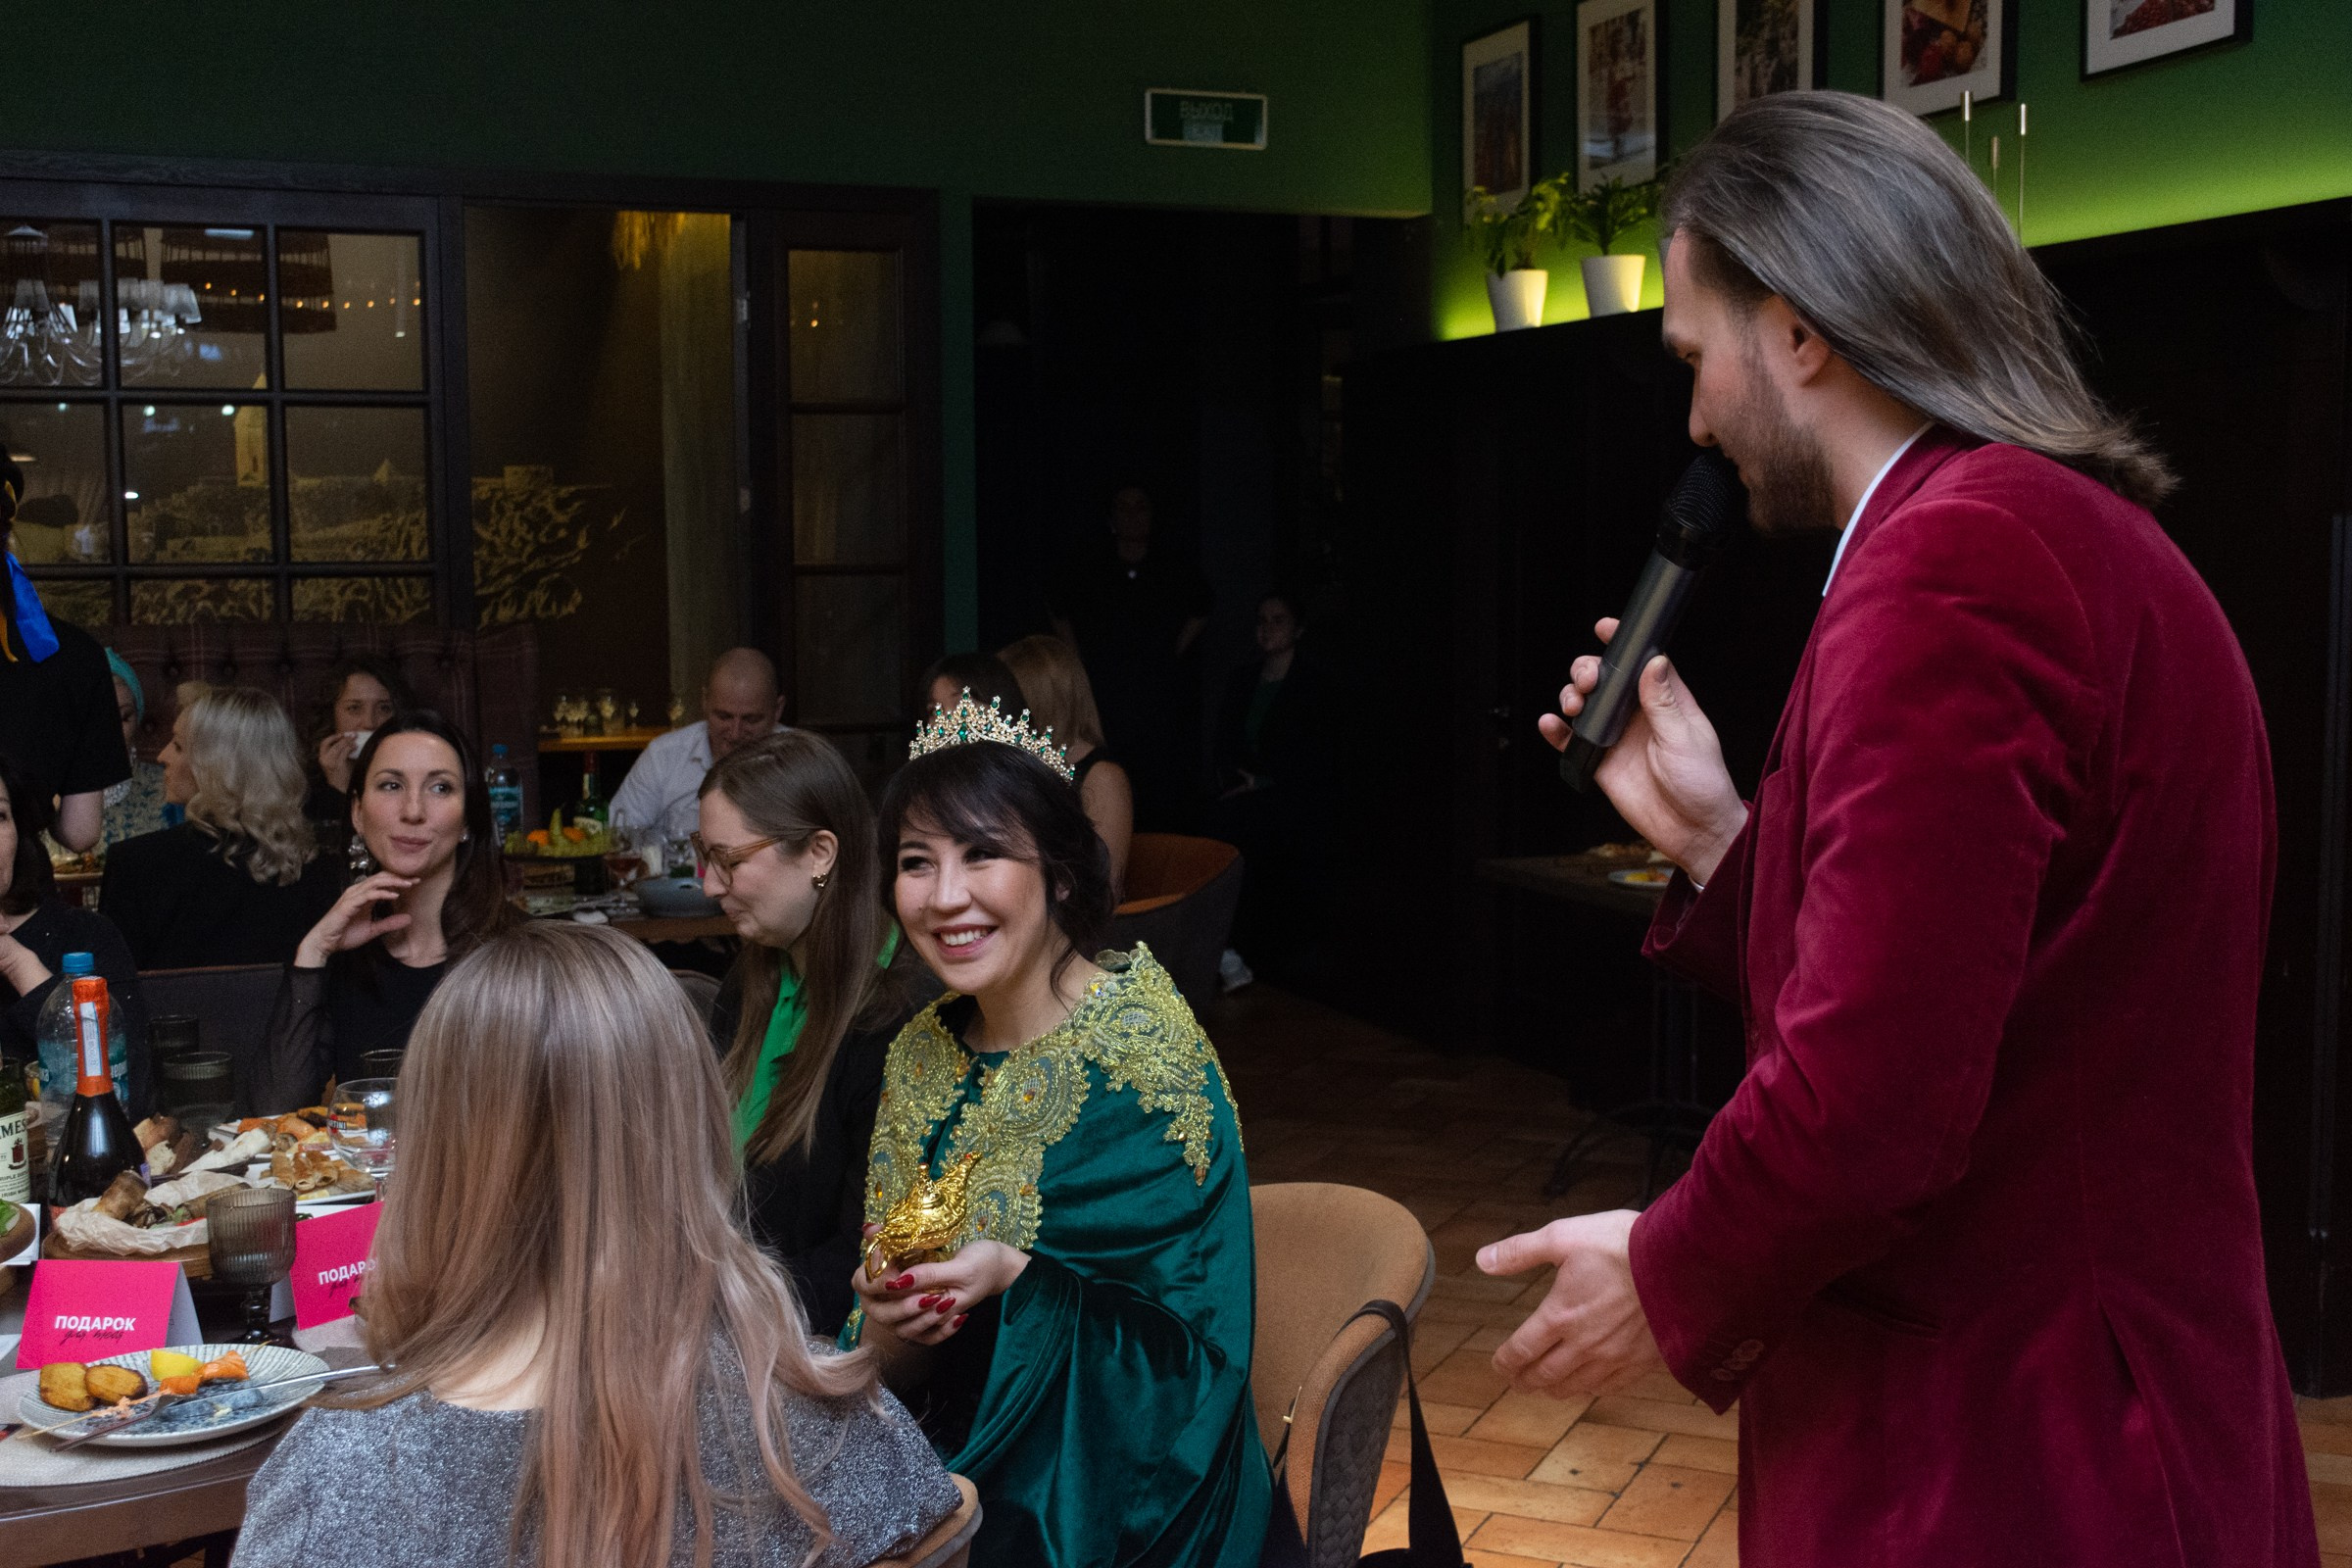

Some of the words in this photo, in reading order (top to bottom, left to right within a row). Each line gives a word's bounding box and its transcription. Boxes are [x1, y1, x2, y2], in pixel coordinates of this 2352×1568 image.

[0, 1117, 26, 1139] MES
[318, 1258, 376, 1286] ПОДАРО
[54, 1315, 136, 1332] ПОДАРОК
